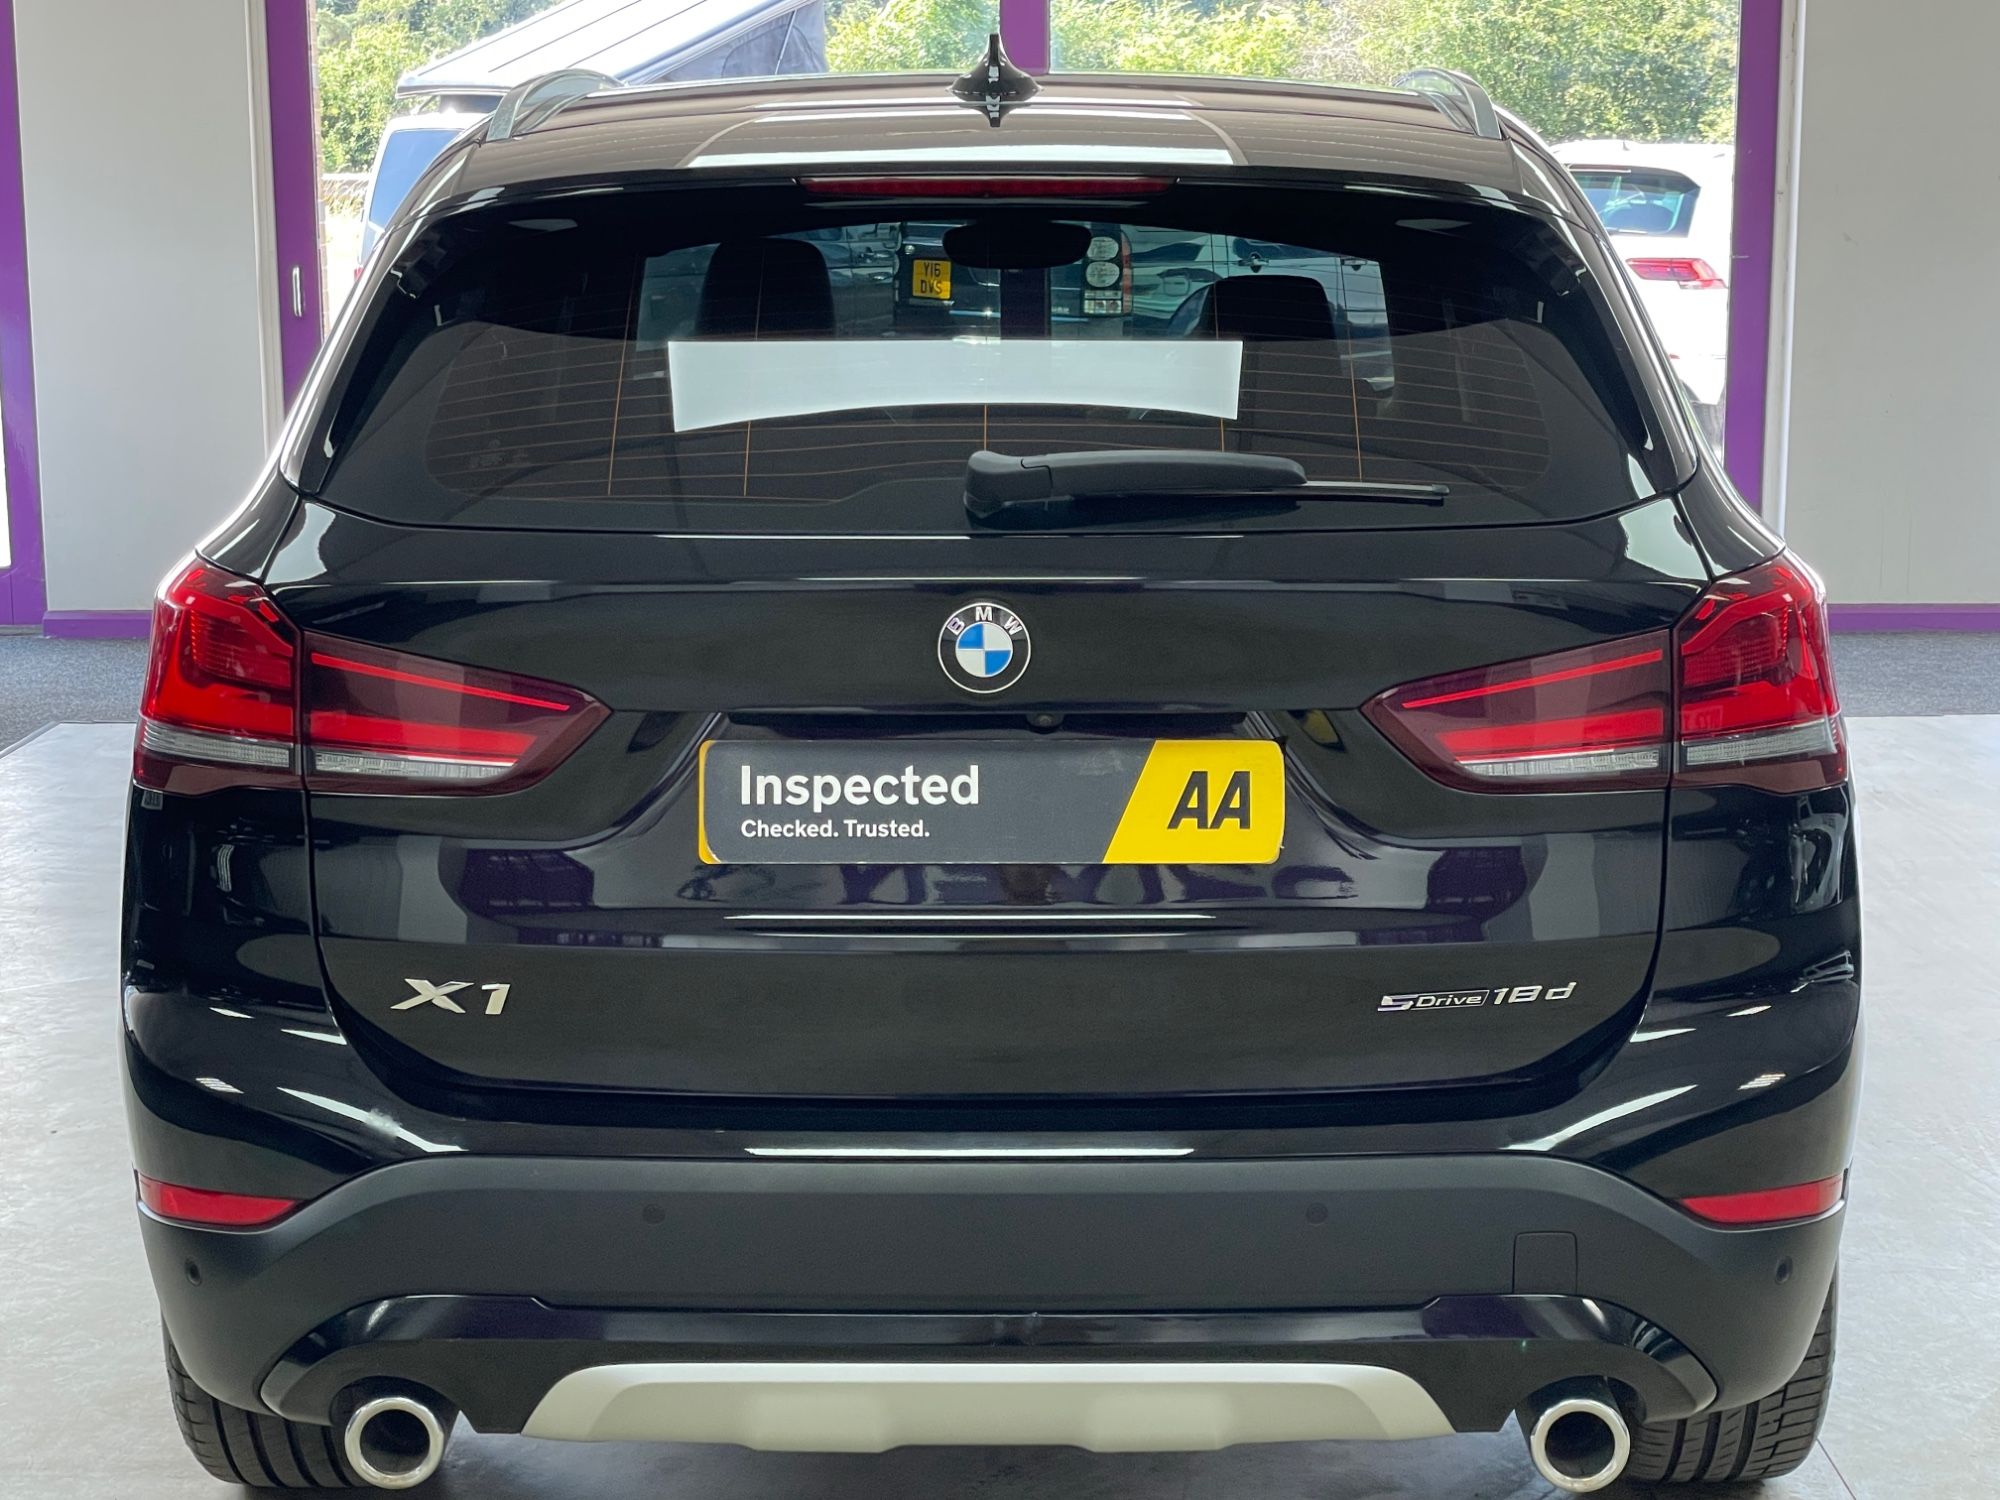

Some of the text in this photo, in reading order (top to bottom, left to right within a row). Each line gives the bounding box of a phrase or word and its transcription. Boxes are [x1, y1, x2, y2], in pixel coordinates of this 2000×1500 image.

[946, 606, 1023, 636] BMW
[740, 764, 980, 813] Inspected
[1166, 770, 1251, 830] AA
[740, 818, 931, 838] Checked. Trusted.
[389, 977, 512, 1016] X1
